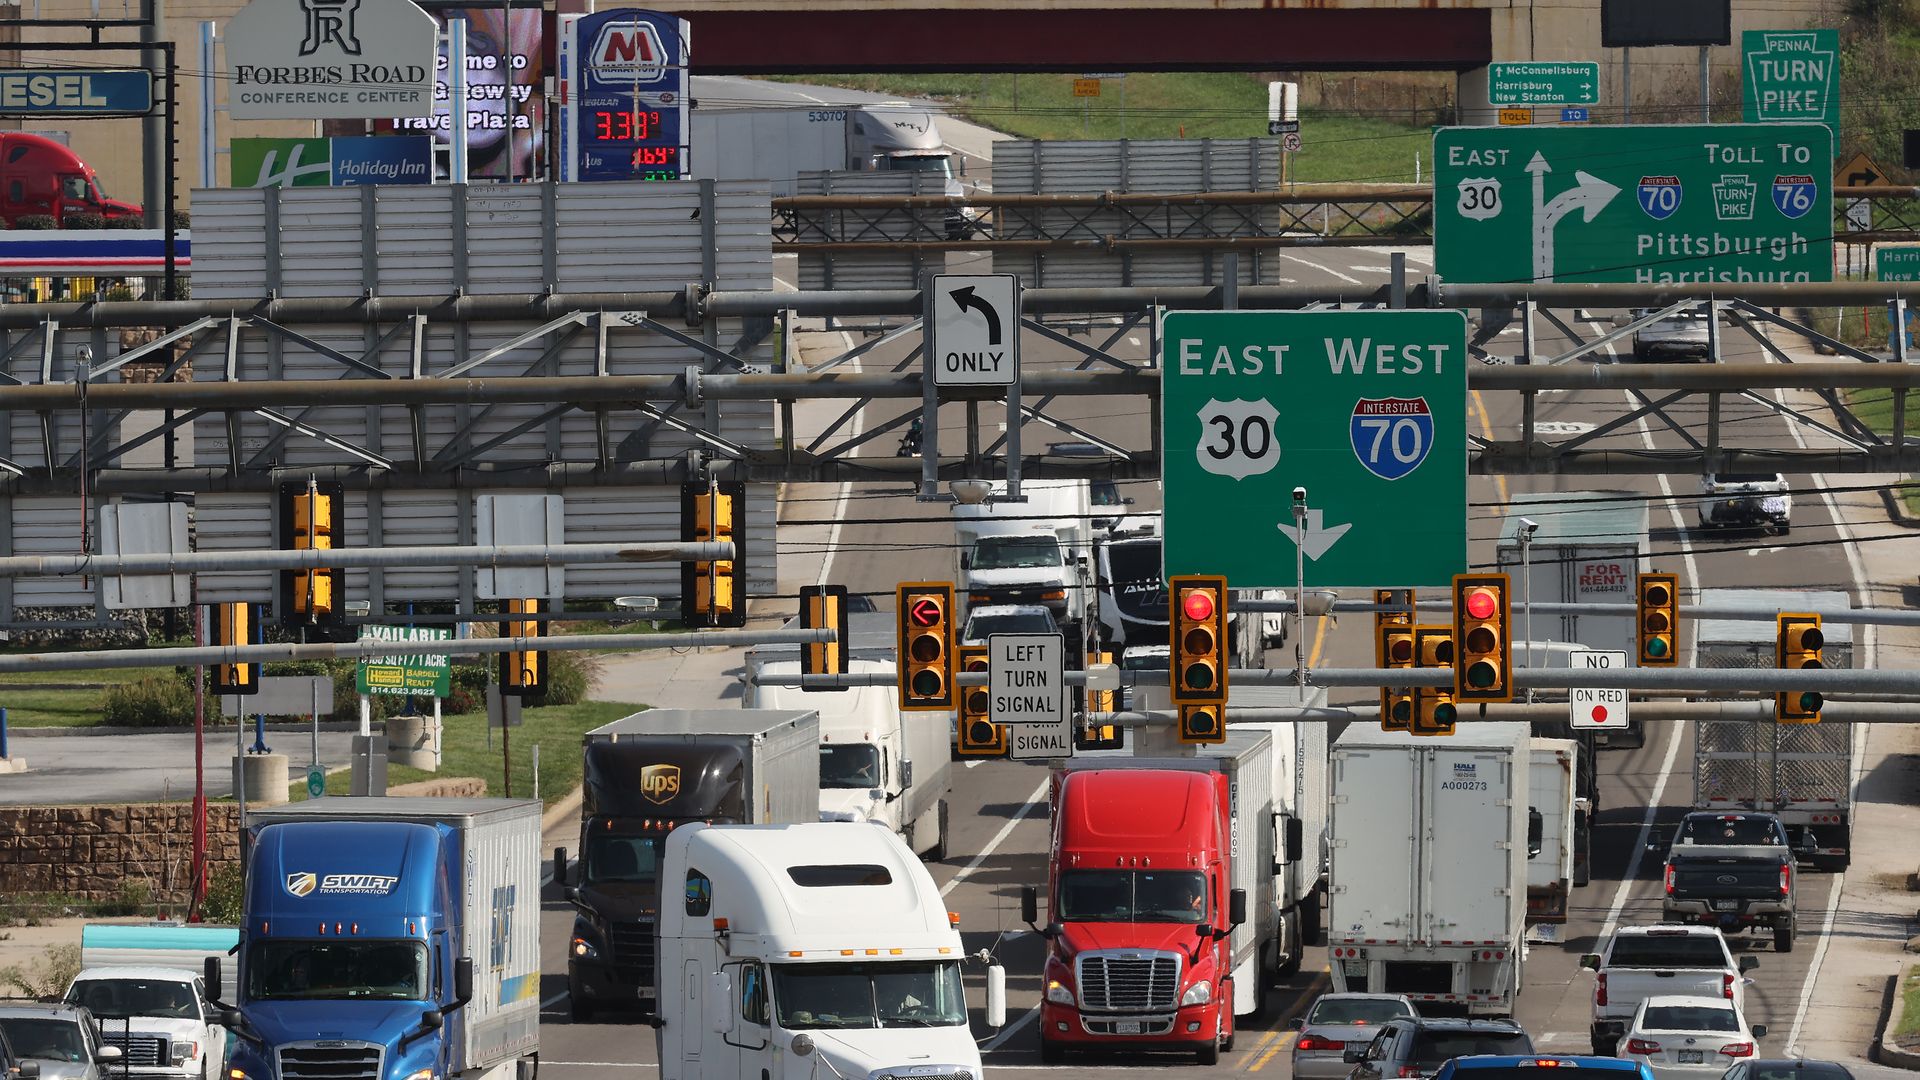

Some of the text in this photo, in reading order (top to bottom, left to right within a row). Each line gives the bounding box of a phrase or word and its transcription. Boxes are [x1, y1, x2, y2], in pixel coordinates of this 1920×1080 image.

[1769, 40, 1811, 52] PENNA
[235, 63, 425, 85] FORBES ROAD
[601, 63, 656, 73] MARATON
[1506, 66, 1590, 77] McConnellsburg
[1760, 60, 1824, 82] TURN
[0, 76, 107, 107] ESEL
[435, 81, 532, 102] Gteway
[1496, 82, 1553, 92] Harrisburg
[241, 92, 420, 104] CONFERENCE CENTER
[1496, 93, 1565, 102] New Stanton
[1763, 90, 1819, 112] PIKE
[467, 112, 530, 129] Plaa
[1567, 110, 1581, 119] TO
[1449, 146, 1510, 165] EAST
[1704, 144, 1810, 163] TOLL TO
[340, 159, 425, 178] Holiday Inn
[1462, 186, 1497, 210] 30
[1643, 187, 1676, 210] 70
[1777, 187, 1809, 210] 76
[1722, 204, 1747, 214] PIKE
[1637, 232, 1808, 261] Pittsburgh
[946, 352, 1004, 372] ONLY
[1180, 337, 1449, 375] EAST WEST
[1363, 402, 1420, 414] INTERSTATE
[1206, 414, 1271, 459] 30
[1361, 418, 1422, 463] 70
[1584, 564, 1621, 575] FOR
[1579, 575, 1627, 586] RENT
[425, 655, 447, 667] ACRE
[1006, 645, 1045, 661] LEFT
[1586, 655, 1610, 669] NO
[406, 669, 440, 678] BARDELL
[1005, 671, 1047, 687] TURN
[406, 678, 434, 686] REALTY
[1576, 690, 1623, 702] ON RED
[997, 696, 1055, 713] SIGNAL
[1017, 736, 1066, 750] SIGNAL
[643, 775, 678, 798] ups
[1441, 782, 1488, 791] A000273
[321, 874, 399, 889] SWIFT
